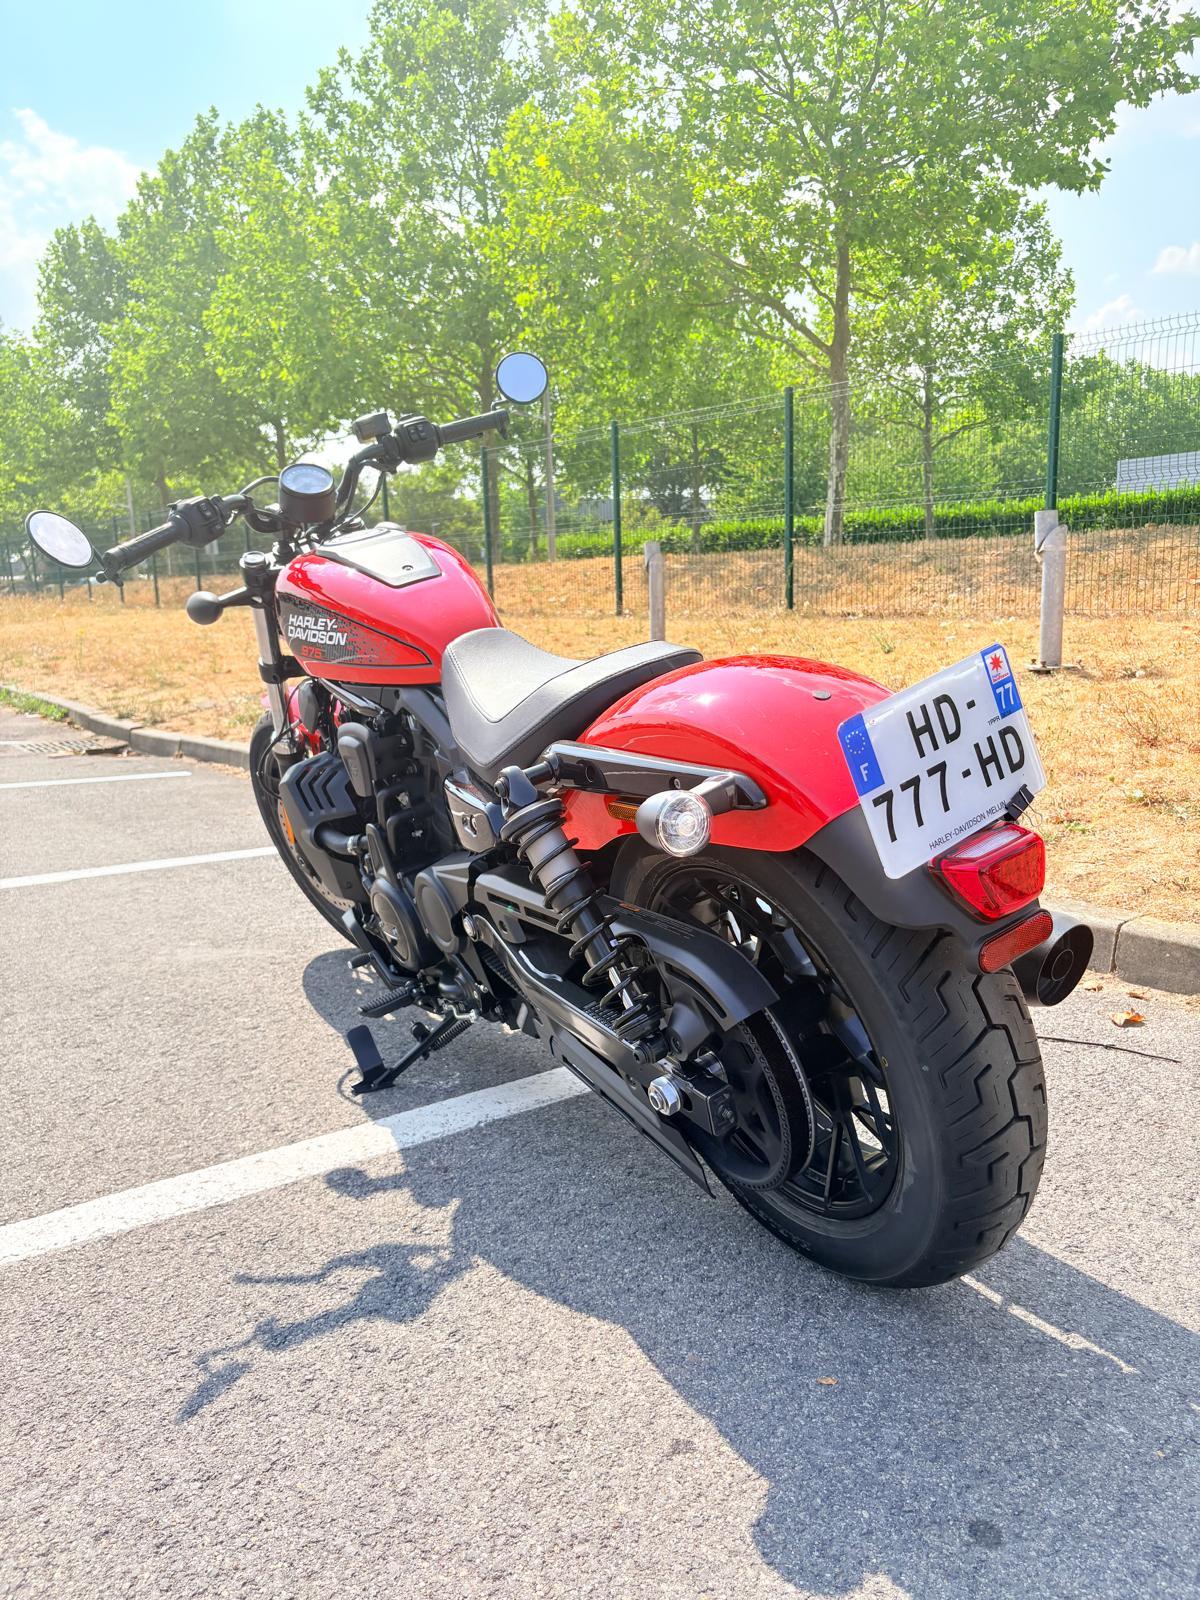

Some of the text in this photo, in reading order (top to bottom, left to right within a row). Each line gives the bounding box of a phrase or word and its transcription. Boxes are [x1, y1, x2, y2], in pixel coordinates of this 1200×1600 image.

[288, 614, 338, 631] HARLEY-
[287, 626, 348, 646] DAVIDSON
[995, 682, 1015, 709] 77
[859, 762, 869, 782] F
[929, 812, 986, 850] HARLEY-DAVIDSON
